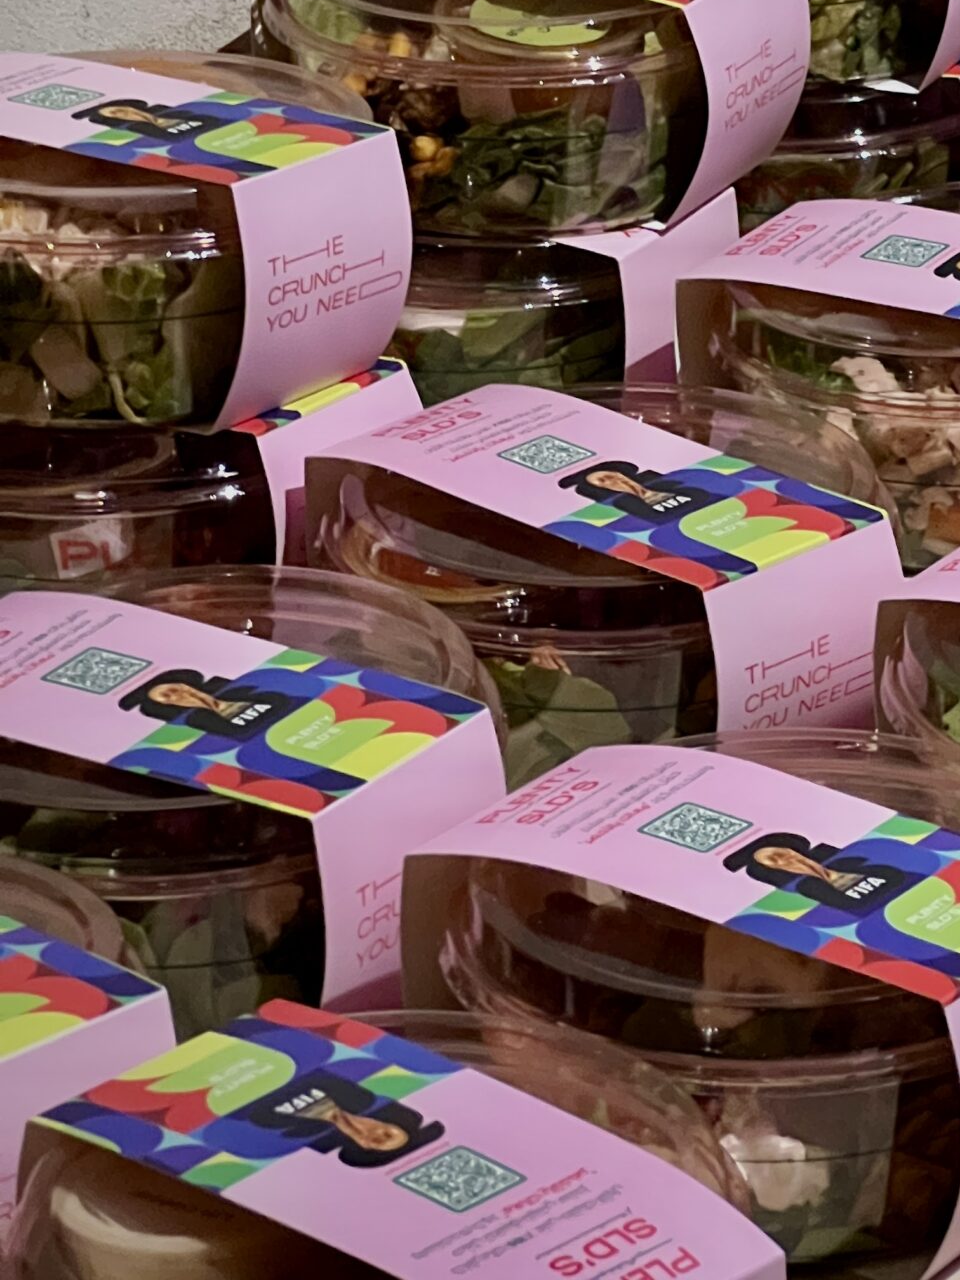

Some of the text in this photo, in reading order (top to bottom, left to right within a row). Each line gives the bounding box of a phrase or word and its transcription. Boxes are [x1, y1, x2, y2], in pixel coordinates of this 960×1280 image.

[267, 235, 344, 277] THE
[268, 249, 385, 306] CRUNCH
[266, 270, 403, 333] YOU NEED
[744, 633, 830, 685] THE
[231, 702, 273, 726] FIFA
[844, 875, 886, 901] FIFA
[274, 1087, 326, 1114] FIFA
[548, 1216, 658, 1277] SLD'S
[620, 1246, 701, 1280] PLE
